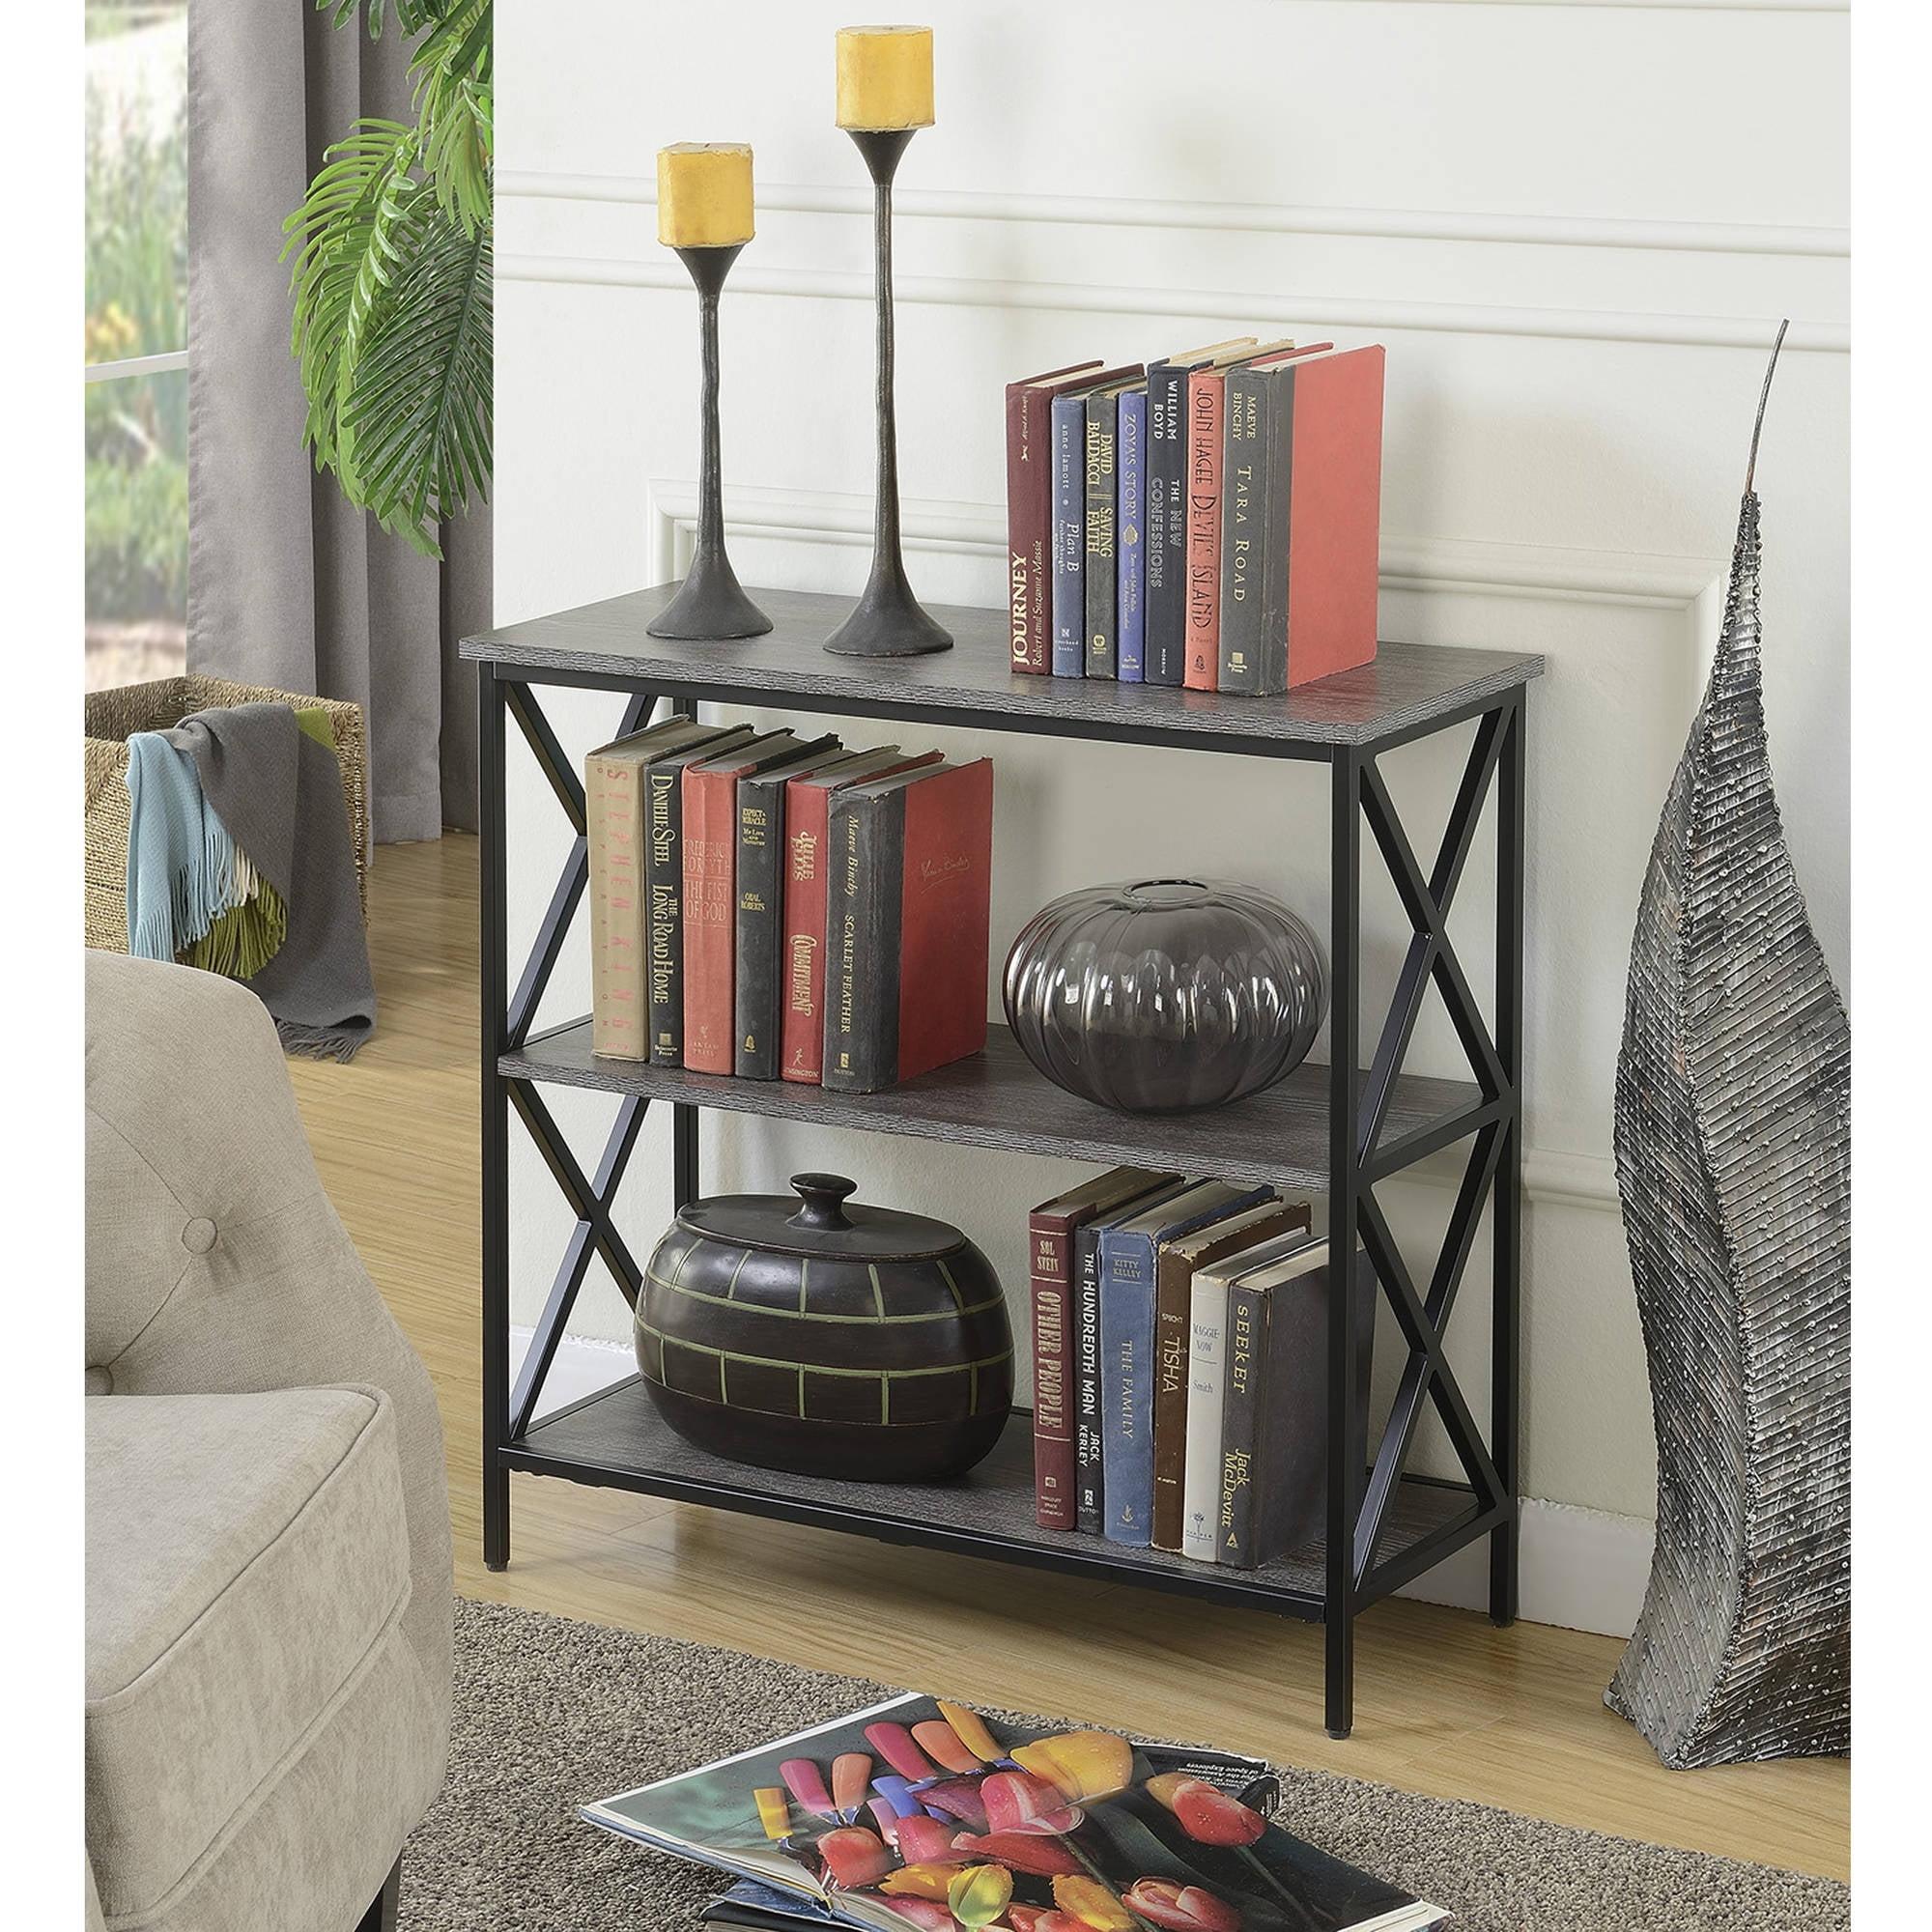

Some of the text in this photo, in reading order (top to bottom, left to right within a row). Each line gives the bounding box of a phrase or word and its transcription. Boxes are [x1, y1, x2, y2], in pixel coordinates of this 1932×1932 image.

[1153, 403, 1164, 440] BOYD
[1167, 380, 1179, 440] WILLIAM
[1196, 387, 1214, 433] JOHN
[1233, 392, 1243, 440] BINCHY
[1246, 396, 1257, 440] MAEVE
[1062, 454, 1071, 489] lamott
[1087, 420, 1101, 485] BALDACCI
[1100, 434, 1113, 474] DAVID
[1123, 413, 1137, 519] ZOYA'S STORY
[1195, 436, 1213, 485] HAGEE
[1088, 511, 1100, 554] FAITH
[1099, 506, 1113, 557] SAVING
[1151, 477, 1163, 588] CONFESSIONS
[1170, 479, 1182, 548] THE NEW
[1235, 466, 1251, 601] TARA ROAD
[1066, 524, 1080, 572] Plan B
[1011, 553, 1030, 666] JOURNEY
[1032, 540, 1044, 667] Robert and Suzanne Massie
[651, 774, 675, 867] DANIELLE STEEL
[801, 831, 817, 880] JULIE
[843, 815, 860, 896] Maeve Binchy
[668, 897, 678, 916] THE
[685, 880, 727, 902] THE FIST
[686, 899, 727, 922] OF GOD
[652, 885, 673, 1004] LONG ROAD HOME
[790, 934, 817, 1016] COMMITMENT
[839, 914, 856, 1034] SCARLET FEATHER
[1039, 1240, 1056, 1256] SOL
[1112, 1267, 1142, 1279] KELLEY
[1113, 1259, 1140, 1269] KITTY
[1082, 1253, 1095, 1415] THE HUNDREDTH MAN
[1037, 1291, 1064, 1430] OTHER PEOPLE
[1162, 1336, 1180, 1393] TISHA
[1121, 1340, 1133, 1438] THE FAMILY
[1078, 1424, 1090, 1467] KERLEY
[1089, 1432, 1099, 1462] JACK
[1235, 1449, 1252, 1486] Jack
[1220, 1450, 1238, 1528] McDevitt
